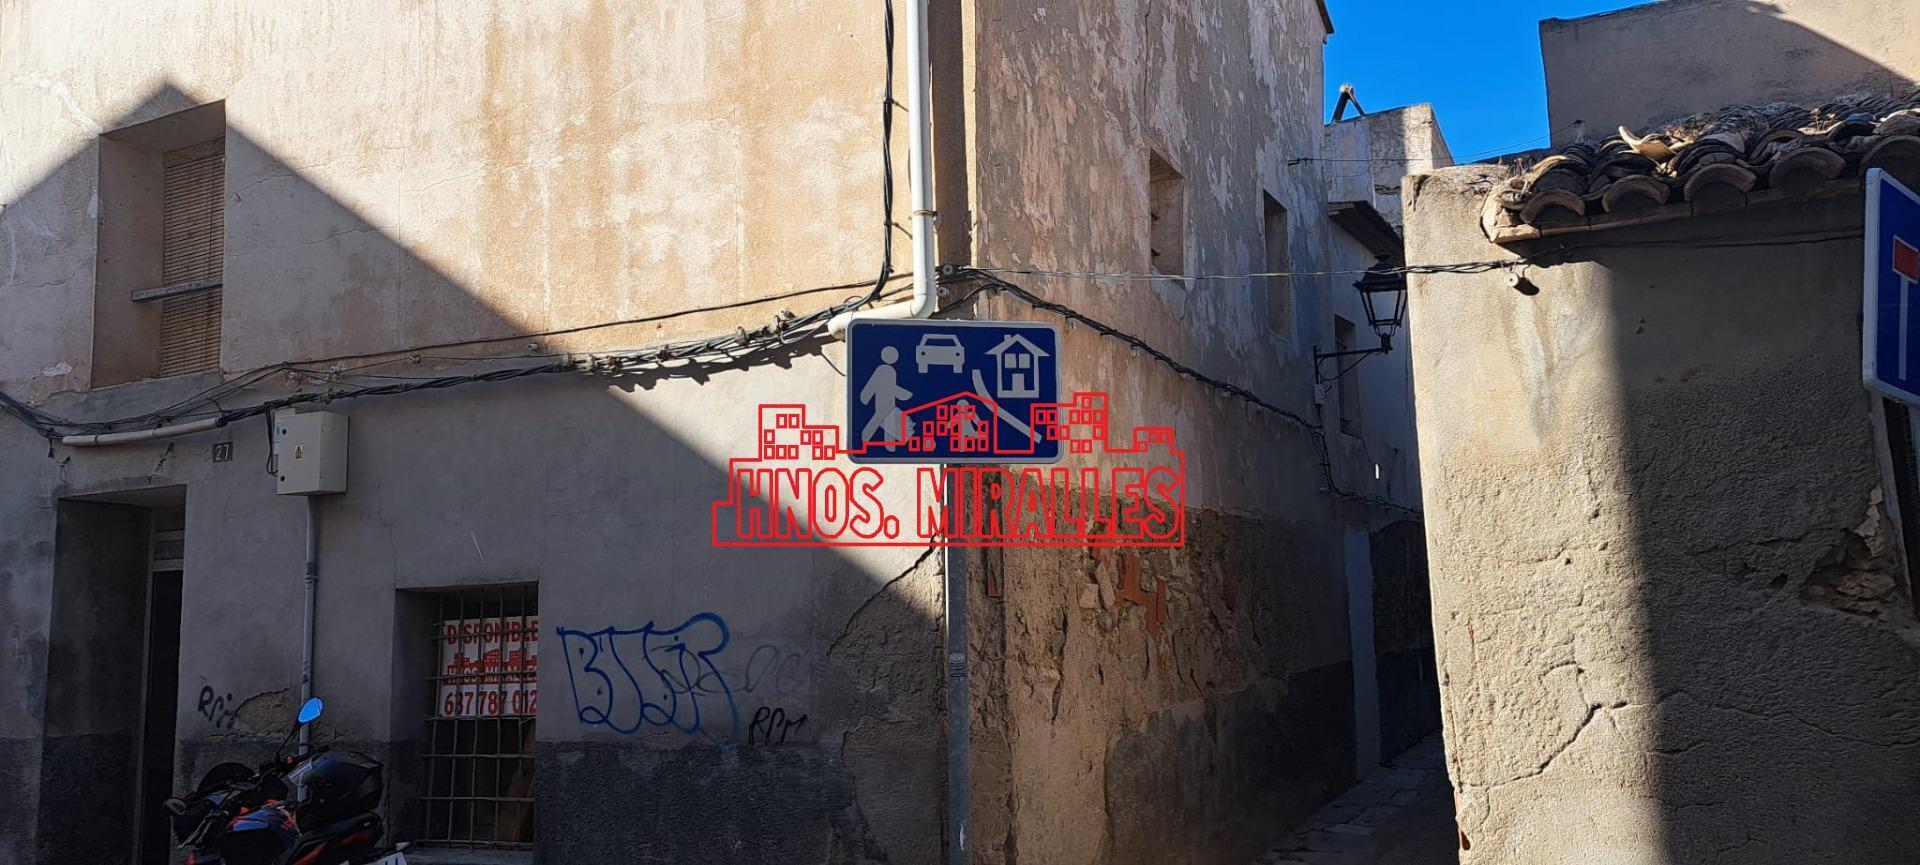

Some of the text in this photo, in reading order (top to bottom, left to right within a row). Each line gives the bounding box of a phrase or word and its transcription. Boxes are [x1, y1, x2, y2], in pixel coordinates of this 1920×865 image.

[215, 444, 230, 461] 27
[445, 689, 538, 715] 637 787 012
